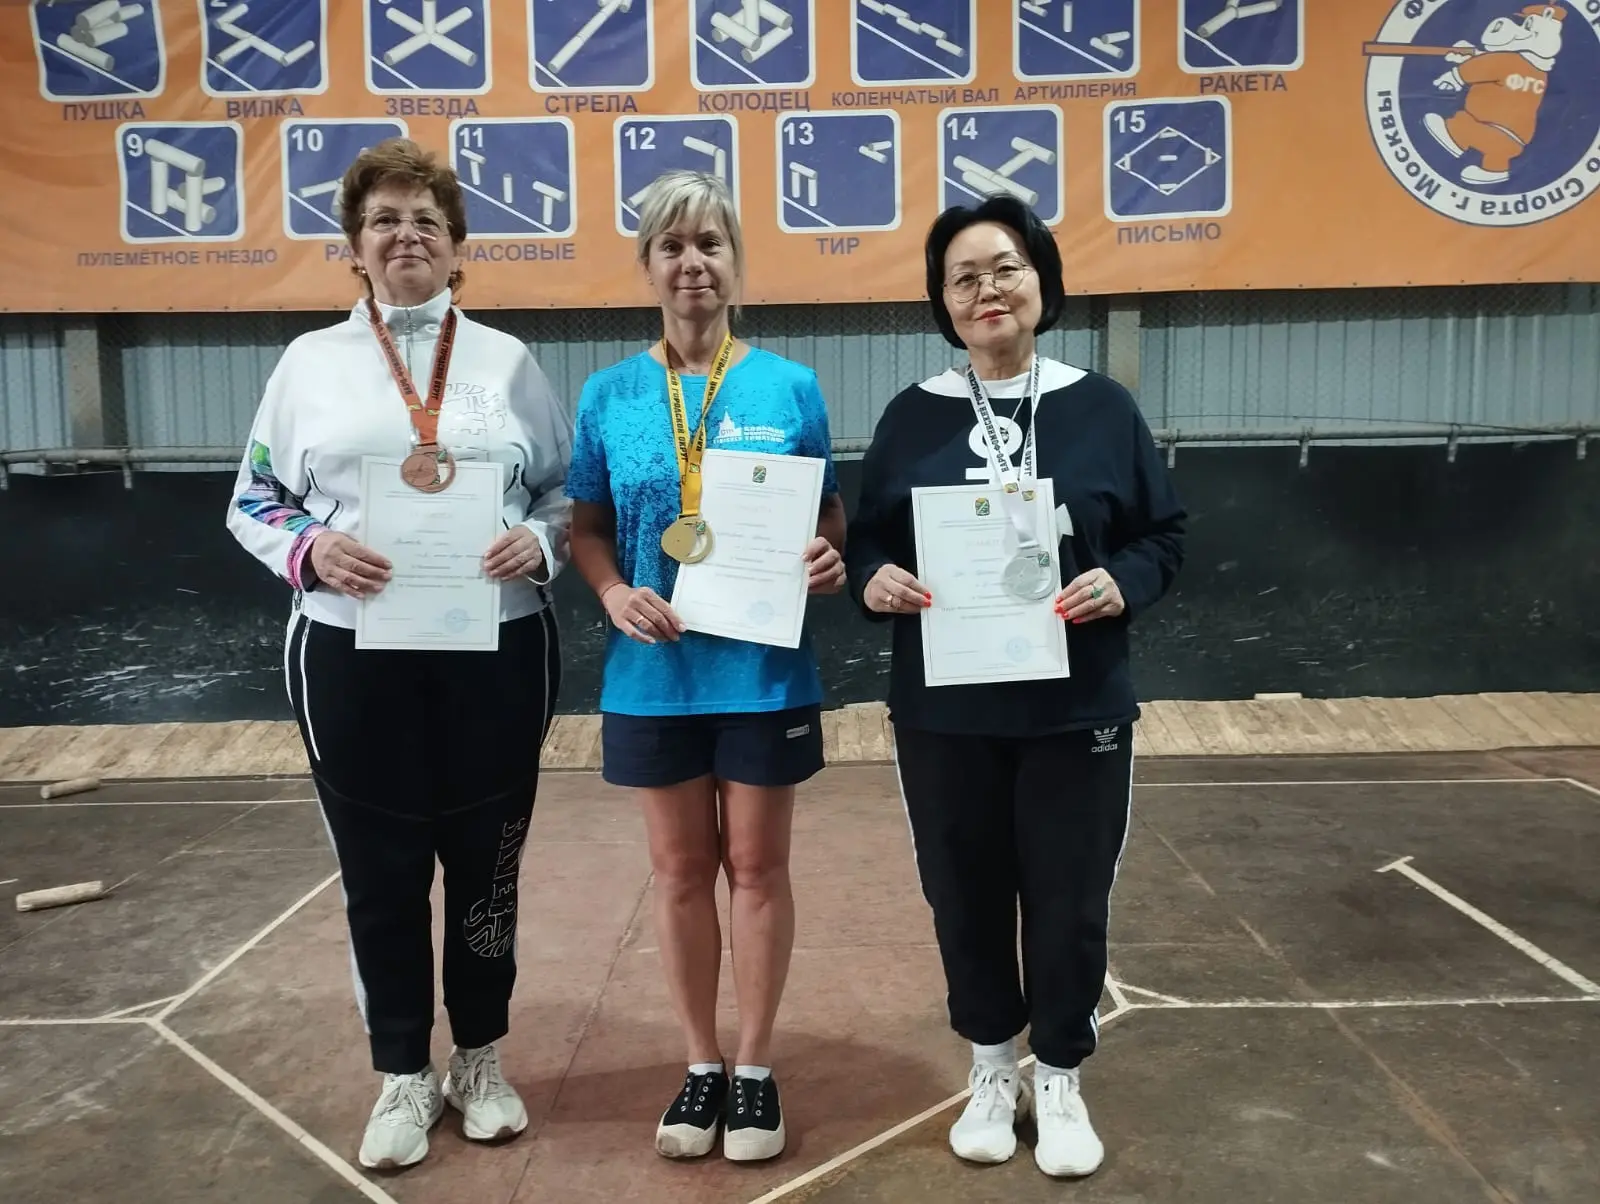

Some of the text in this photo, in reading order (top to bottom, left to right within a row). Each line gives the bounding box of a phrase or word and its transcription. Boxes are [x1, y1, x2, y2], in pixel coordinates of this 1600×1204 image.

[1014, 82, 1137, 100] АРТИЛЛЕРИЯ
[1200, 74, 1288, 93] РАКЕТА
[1505, 73, 1545, 94] ФГС
[385, 97, 479, 117] ЗВЕЗДА
[545, 95, 639, 113] СТРЕЛА
[698, 92, 810, 113] КОЛОДЕЦ
[831, 88, 999, 107] КОЛЕНЧАТЫЙ ВАЛ
[63, 102, 146, 121] ПУШКА
[227, 100, 304, 118] ВИЛКА
[946, 117, 978, 141] 14
[1114, 110, 1146, 134] 15
[291, 128, 324, 152] 10
[459, 127, 483, 148] 11
[624, 127, 656, 151] 12
[783, 122, 815, 146] 13
[126, 133, 144, 158] 9
[1377, 90, 1441, 200] Москвы
[1480, 177, 1585, 216] Спорта
[1117, 222, 1221, 246] ПИСЬМО
[815, 237, 860, 255] ТИР
[77, 248, 278, 268] ПУЛЕМЁТНОЕ ГНЕЗДО
[672, 388, 685, 434] ГОРОДСКОЙ
[678, 436, 689, 462] ОКРУГ
[1091, 743, 1118, 753] adidas
